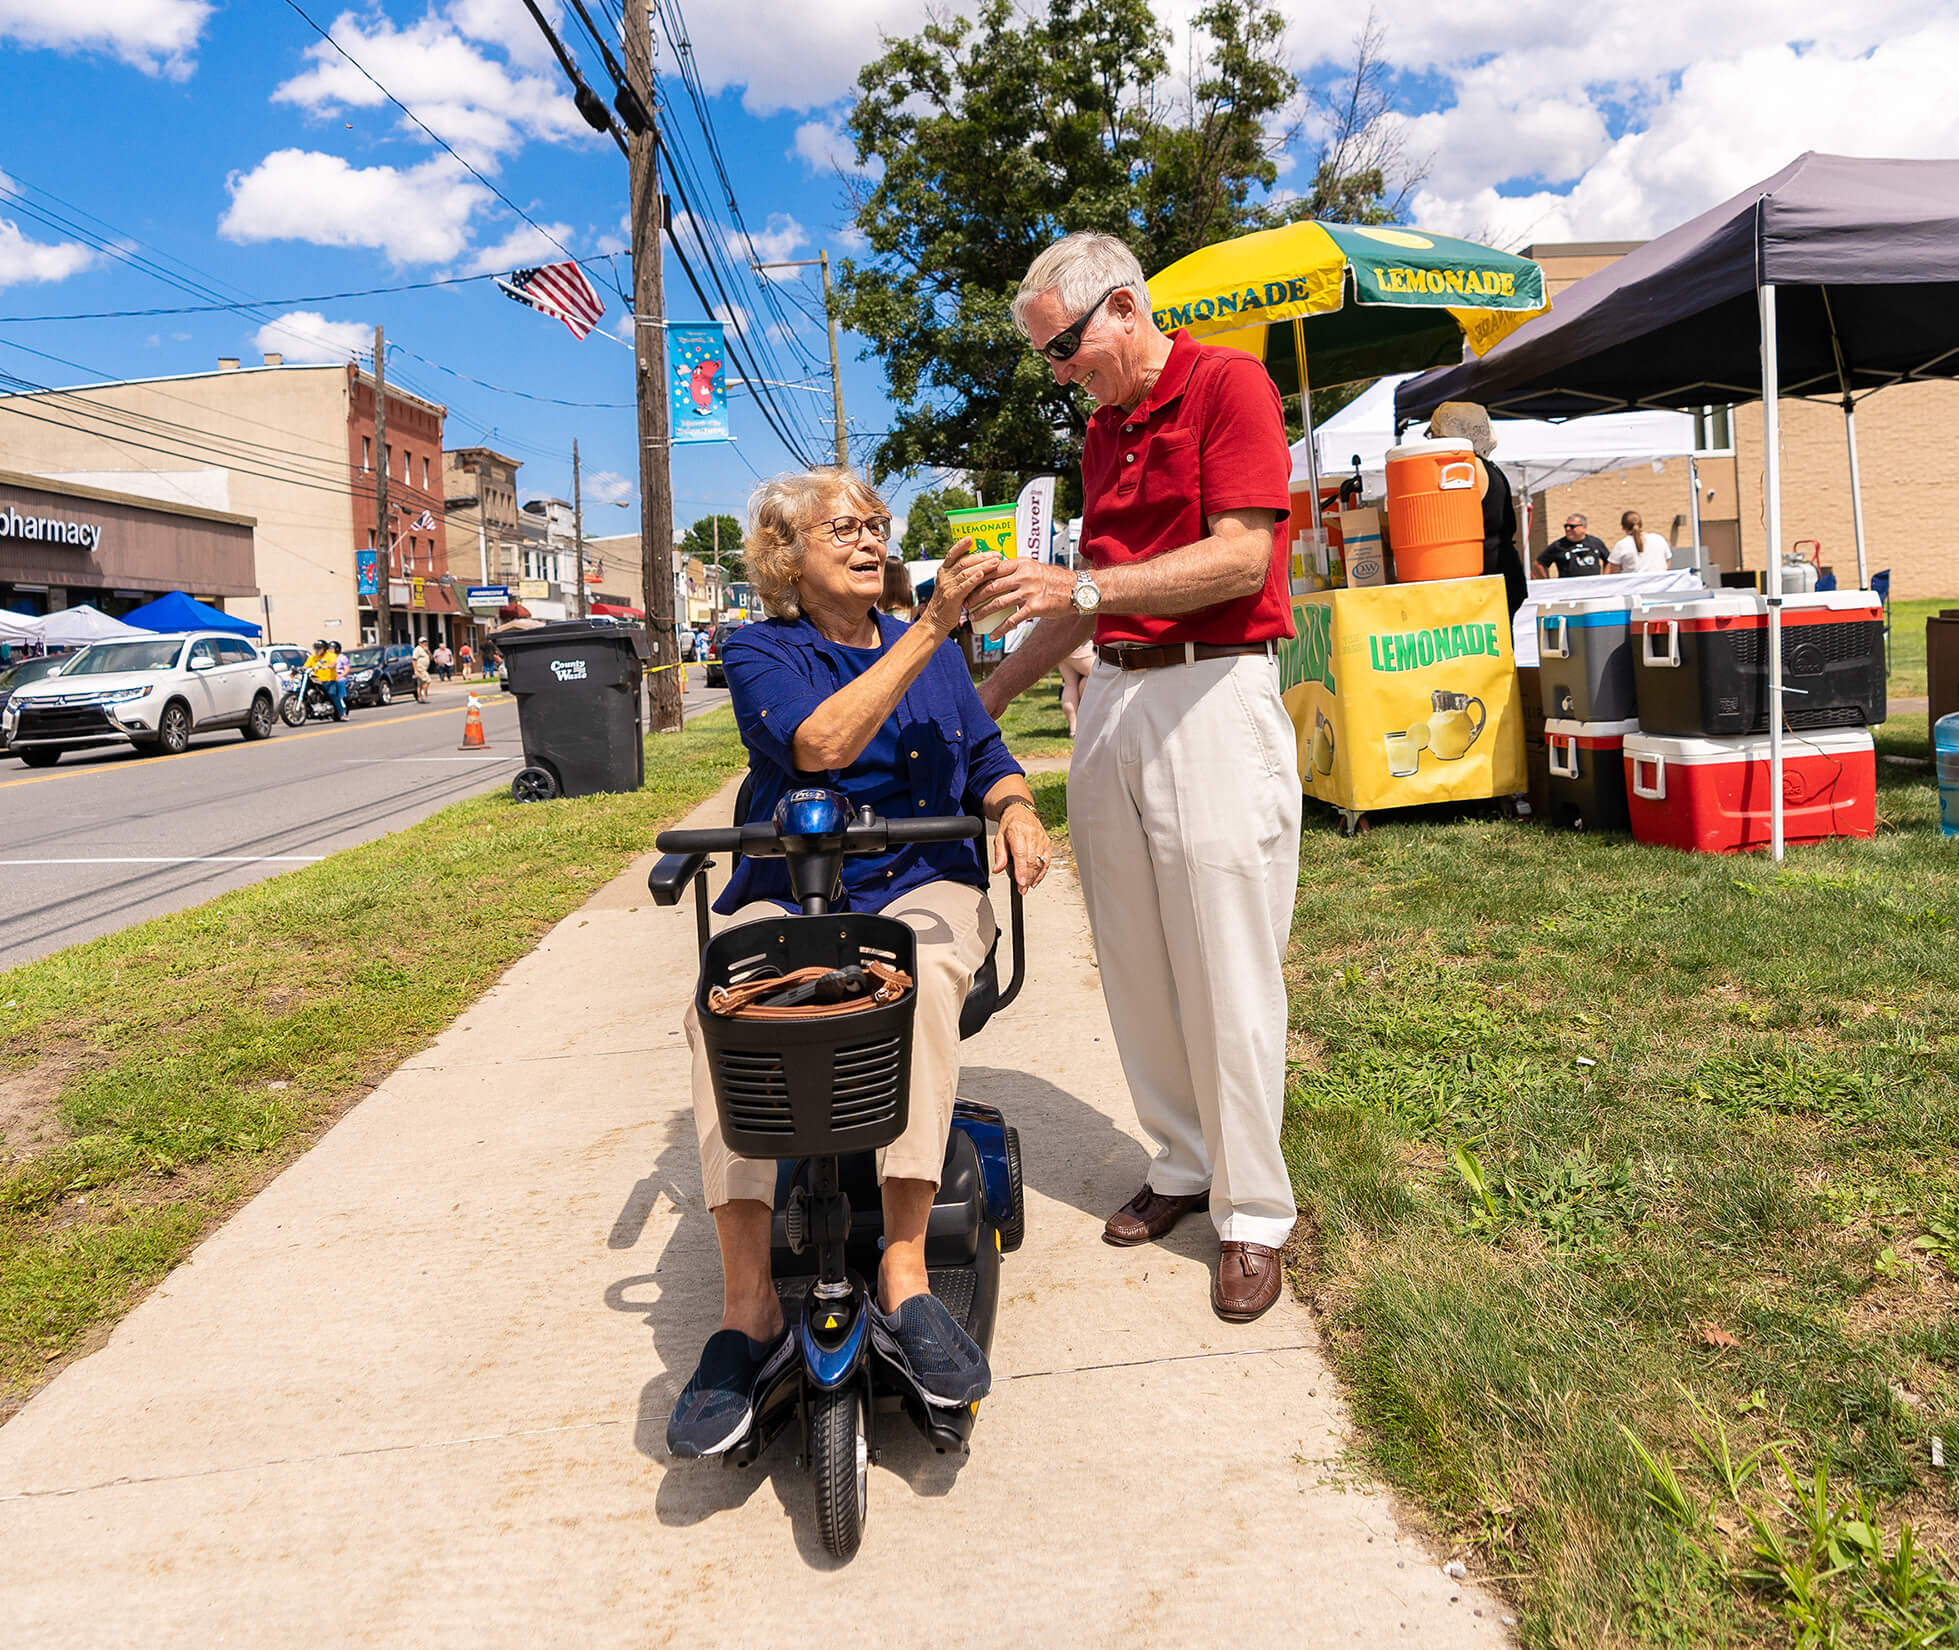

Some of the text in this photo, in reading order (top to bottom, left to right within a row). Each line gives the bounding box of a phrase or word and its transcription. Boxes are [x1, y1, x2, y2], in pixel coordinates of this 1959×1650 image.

[1373, 268, 1516, 297] LEMONADE
[1152, 277, 1309, 332] EMONADE
[1028, 496, 1041, 561] nSaver
[550, 660, 585, 671] County
[1369, 623, 1499, 672] LEMONADE
[555, 669, 587, 682] Waste
